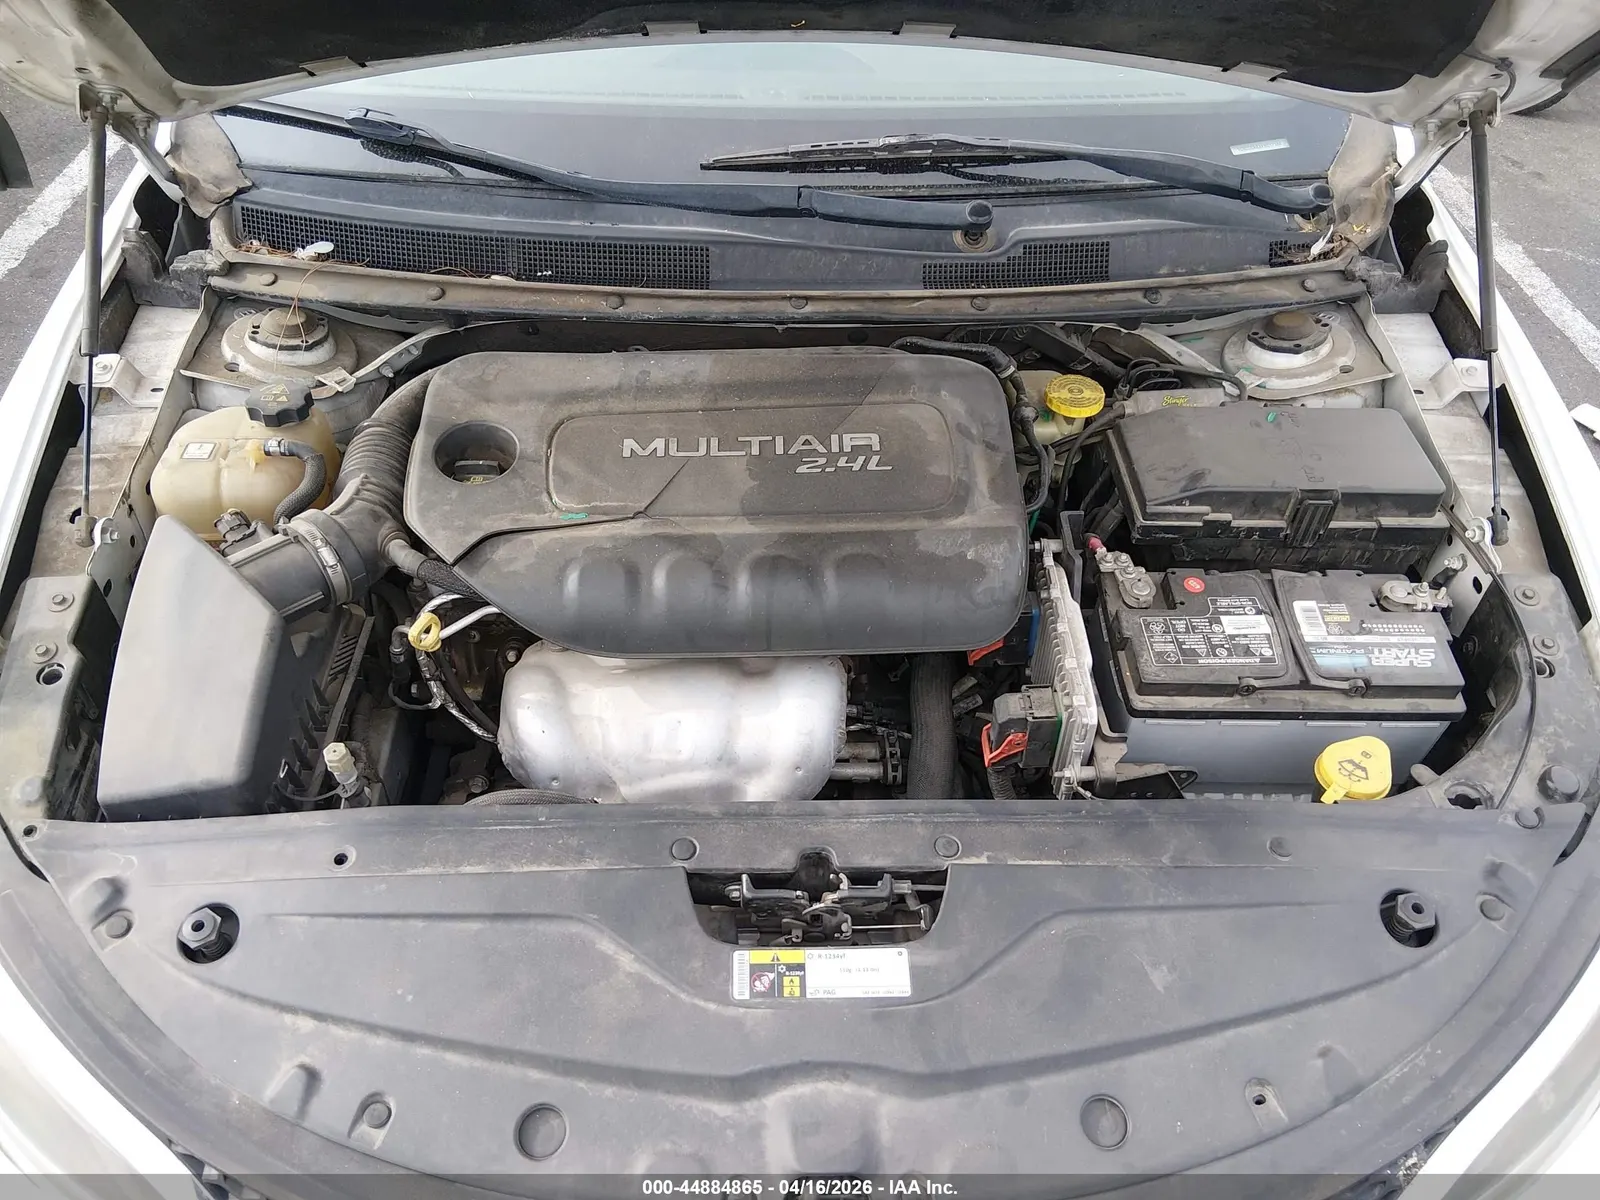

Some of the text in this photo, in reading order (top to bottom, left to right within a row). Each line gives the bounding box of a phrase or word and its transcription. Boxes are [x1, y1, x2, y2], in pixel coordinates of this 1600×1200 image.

[622, 432, 881, 458] MULTIAIR
[795, 455, 893, 473] 2.4L
[1372, 648, 1436, 659] START
[1371, 657, 1432, 667] SUPER
